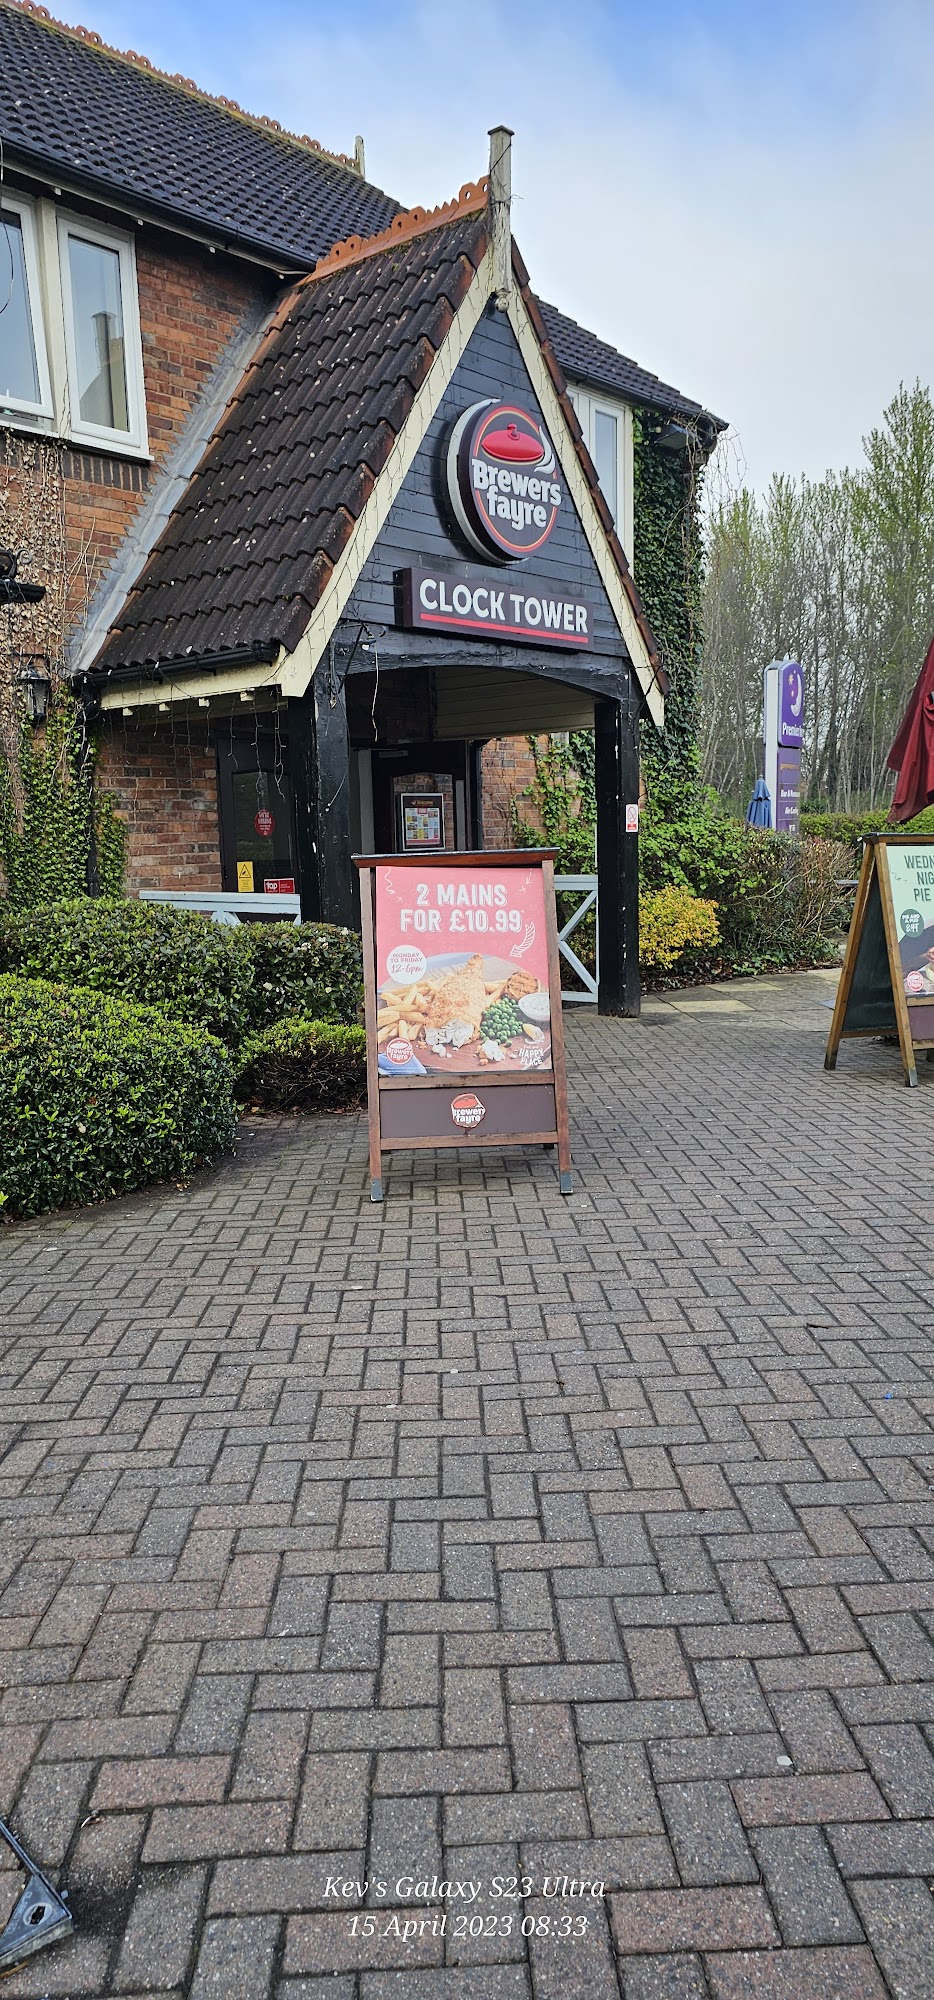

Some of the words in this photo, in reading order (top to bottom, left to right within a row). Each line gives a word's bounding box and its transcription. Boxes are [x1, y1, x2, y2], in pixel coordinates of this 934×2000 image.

[472, 458, 562, 507] Brewers
[486, 484, 547, 531] fayre
[420, 578, 505, 621] CLOCK
[510, 592, 588, 634] TOWER
[416, 883, 430, 906] 2
[437, 883, 507, 907] MAINS
[913, 888, 931, 902] PIE
[400, 908, 441, 932] FOR
[518, 1048, 545, 1059] HAPPY
[520, 1056, 543, 1067] PLACE
